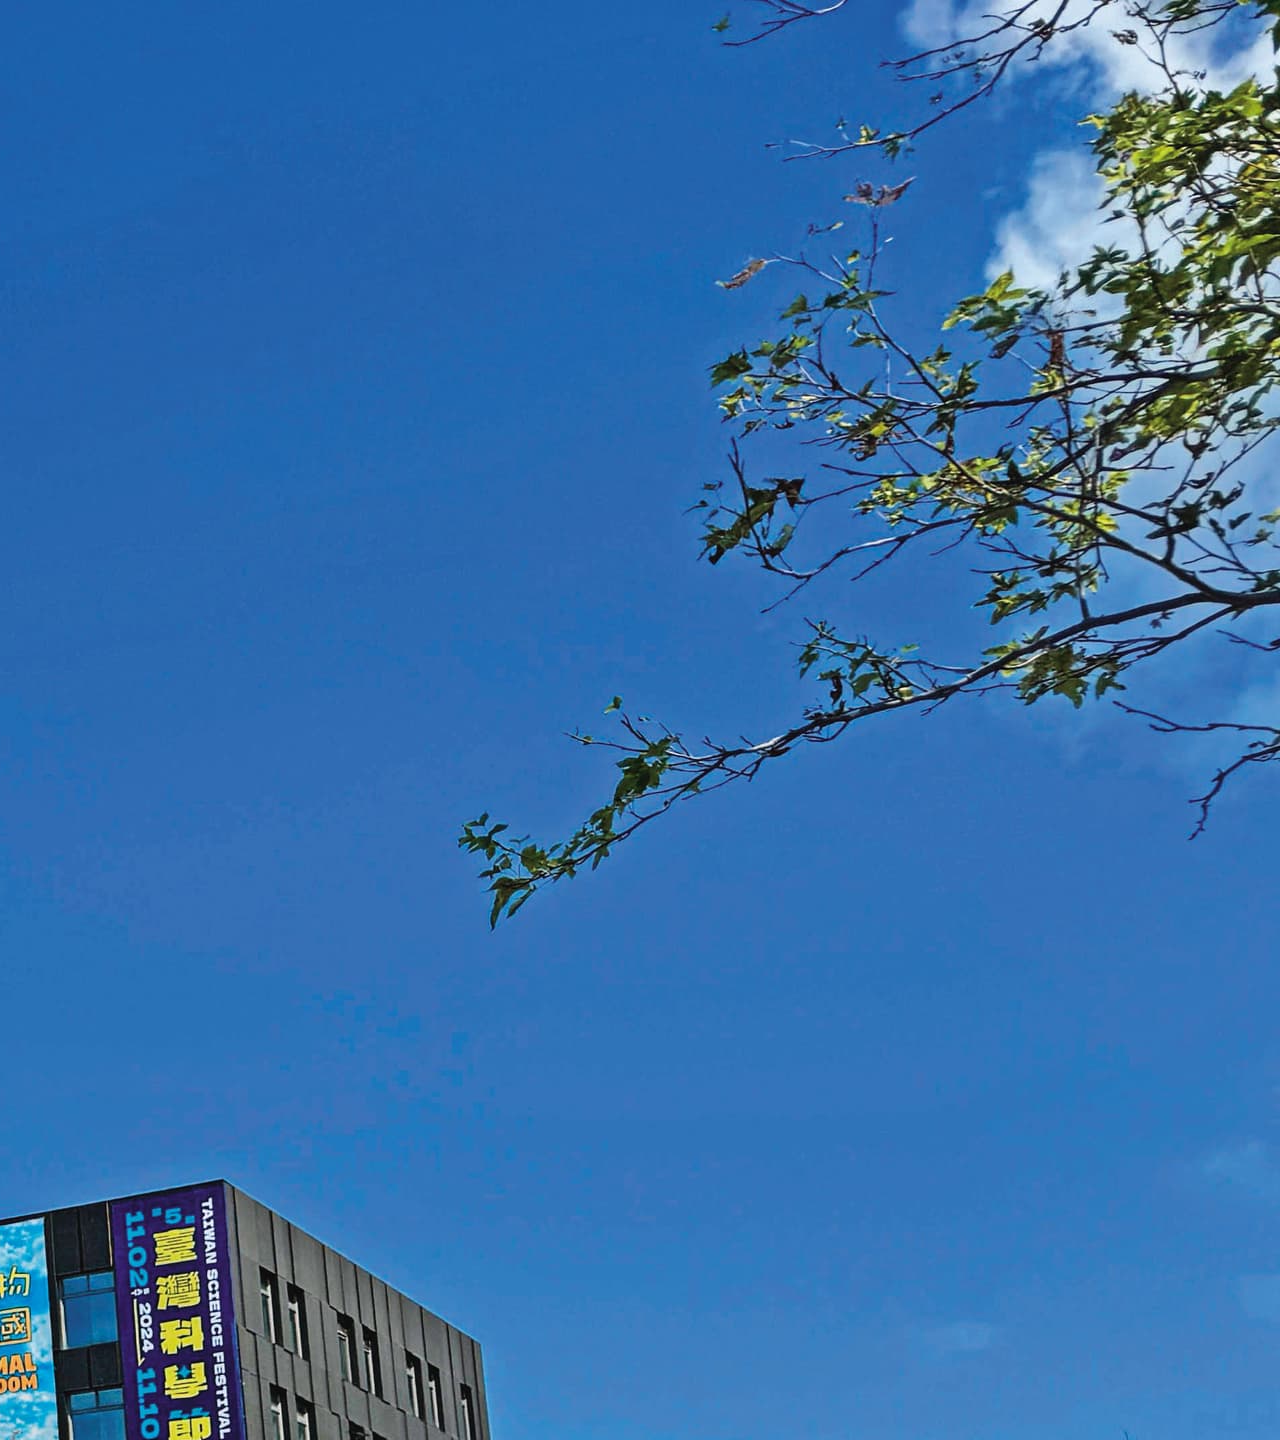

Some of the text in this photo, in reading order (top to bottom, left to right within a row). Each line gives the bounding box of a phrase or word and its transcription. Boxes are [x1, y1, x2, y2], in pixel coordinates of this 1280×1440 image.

[125, 1211, 149, 1288] 11.02
[139, 1302, 154, 1352] 2024
[201, 1198, 232, 1440] TAIWAN SCIENCE FESTIVAL
[136, 1367, 160, 1439] 11.10
